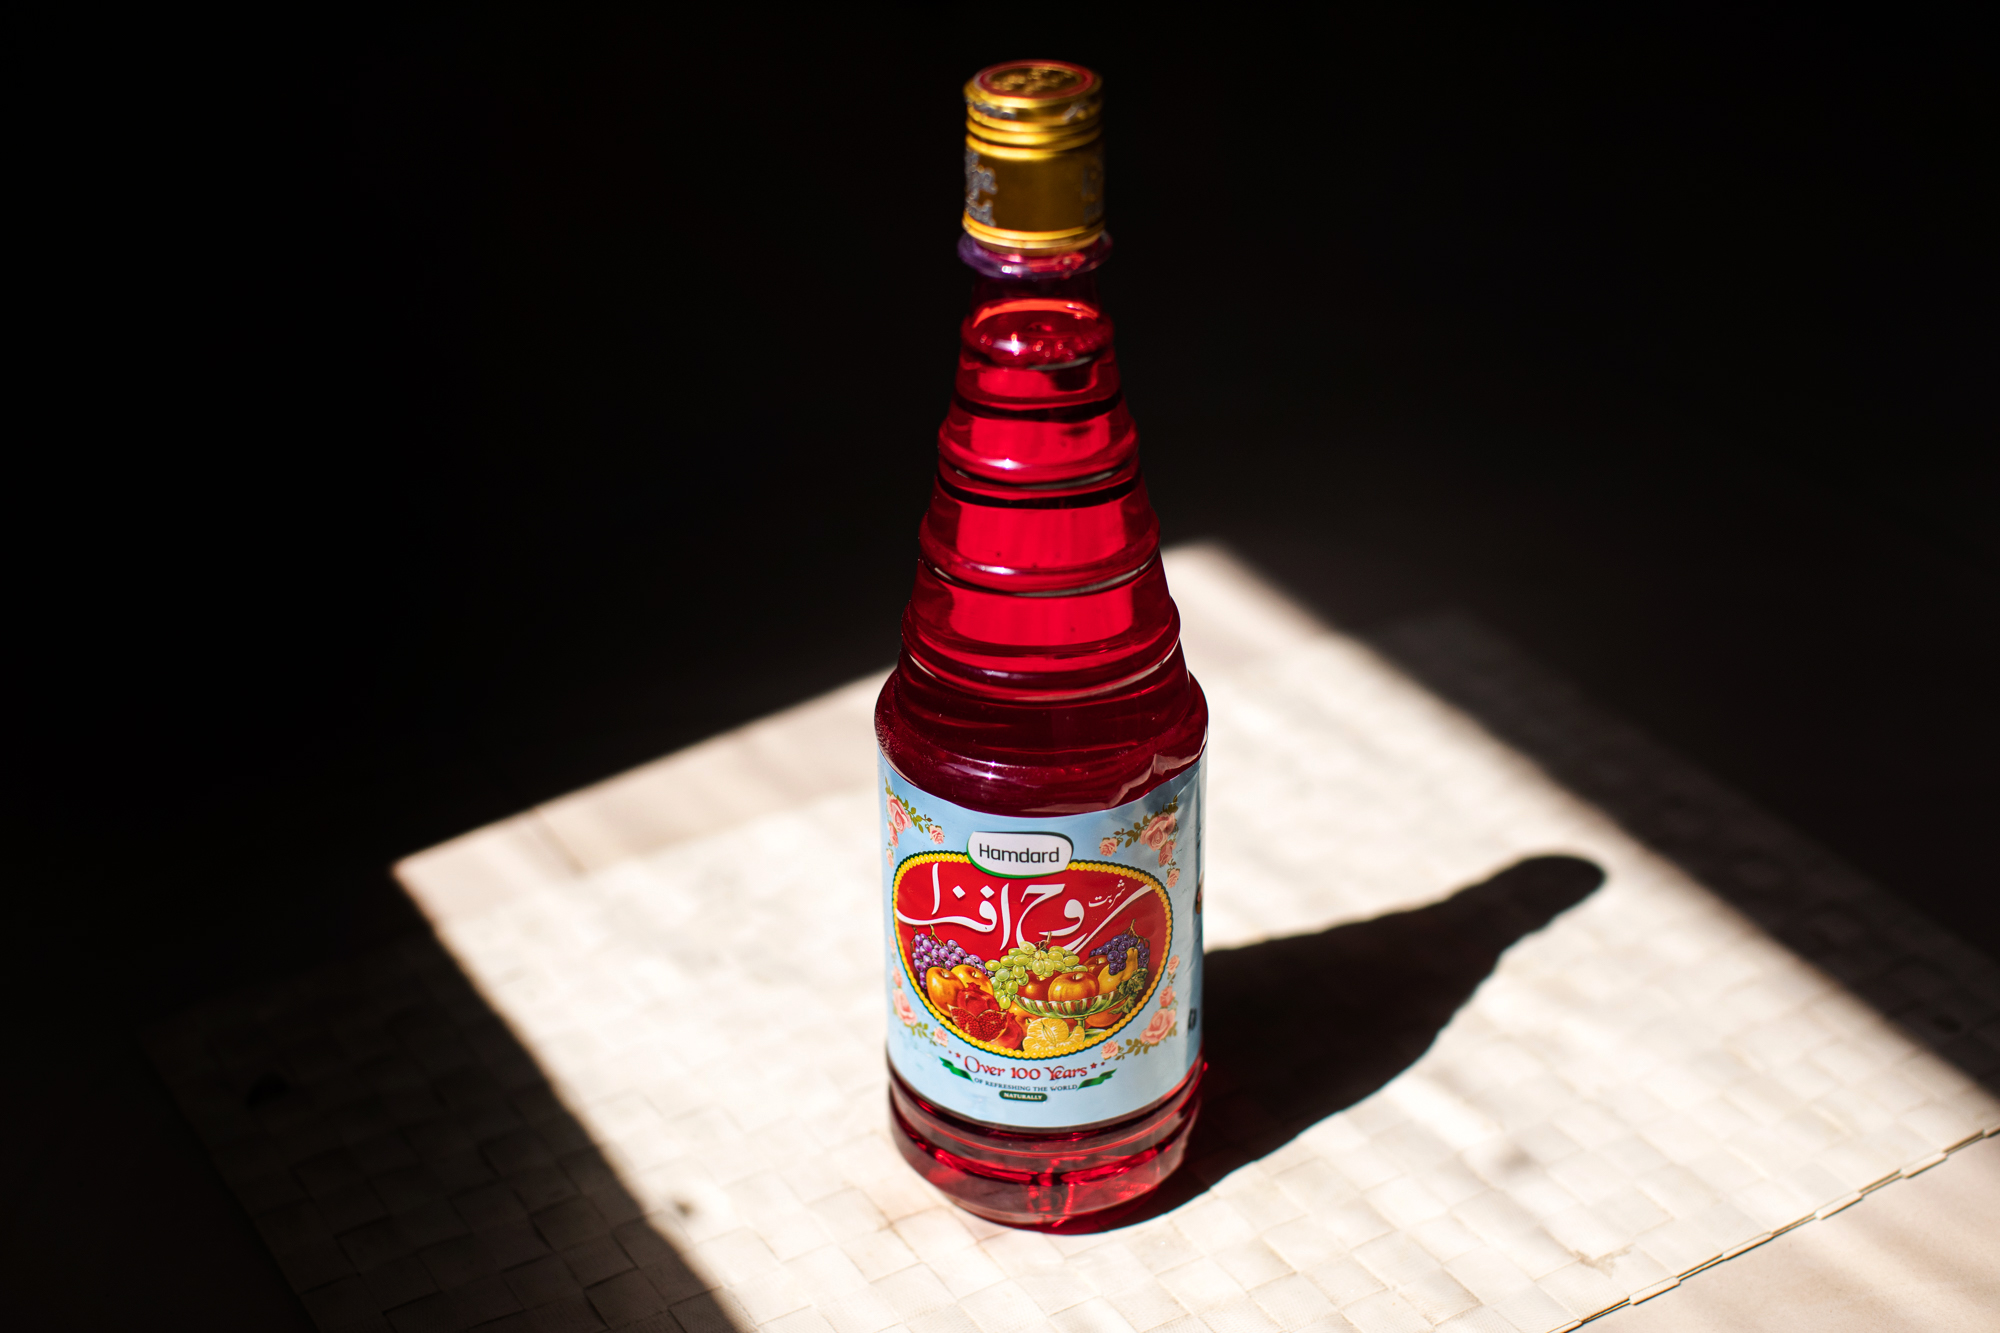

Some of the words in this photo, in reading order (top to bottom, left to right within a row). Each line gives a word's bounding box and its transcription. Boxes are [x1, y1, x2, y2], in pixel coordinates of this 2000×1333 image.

[979, 843, 1060, 864] Hamdard
[1088, 878, 1126, 909] شربت
[896, 863, 1010, 952] افزا
[1016, 882, 1153, 953] روح
[964, 1055, 1004, 1076] Over
[1010, 1067, 1041, 1080] 100
[1044, 1065, 1087, 1081] Years
[985, 1080, 1030, 1091] REFRESHING
[1050, 1084, 1078, 1092] WORLD
[1003, 1092, 1043, 1100] NATURALLY
